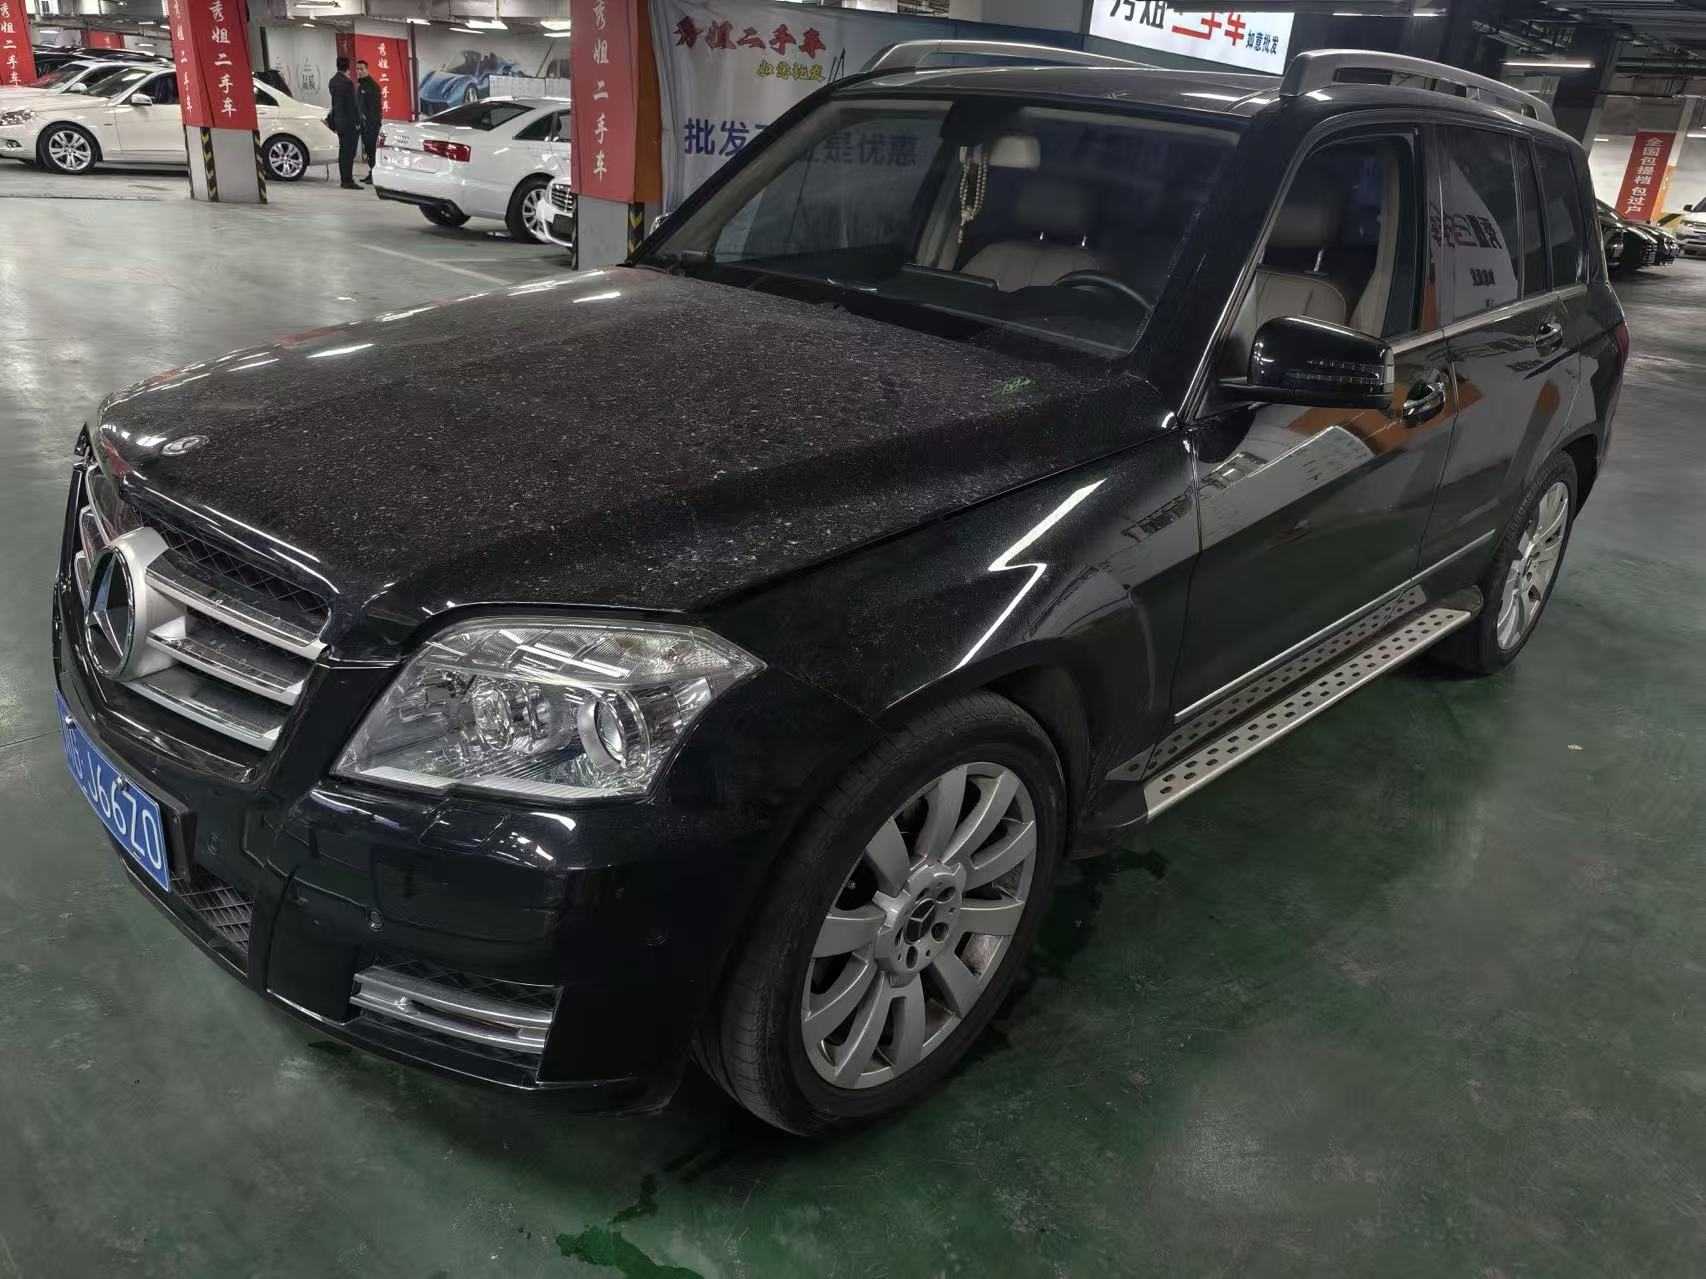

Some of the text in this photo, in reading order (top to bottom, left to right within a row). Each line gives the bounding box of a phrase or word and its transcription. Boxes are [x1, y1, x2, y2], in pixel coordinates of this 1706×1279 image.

[0, 2, 21, 86] 秀姐二手车
[209, 0, 237, 118] 秀姐二手车
[673, 15, 827, 60] 秀姐二手车
[592, 0, 609, 183] 秀姐二手车
